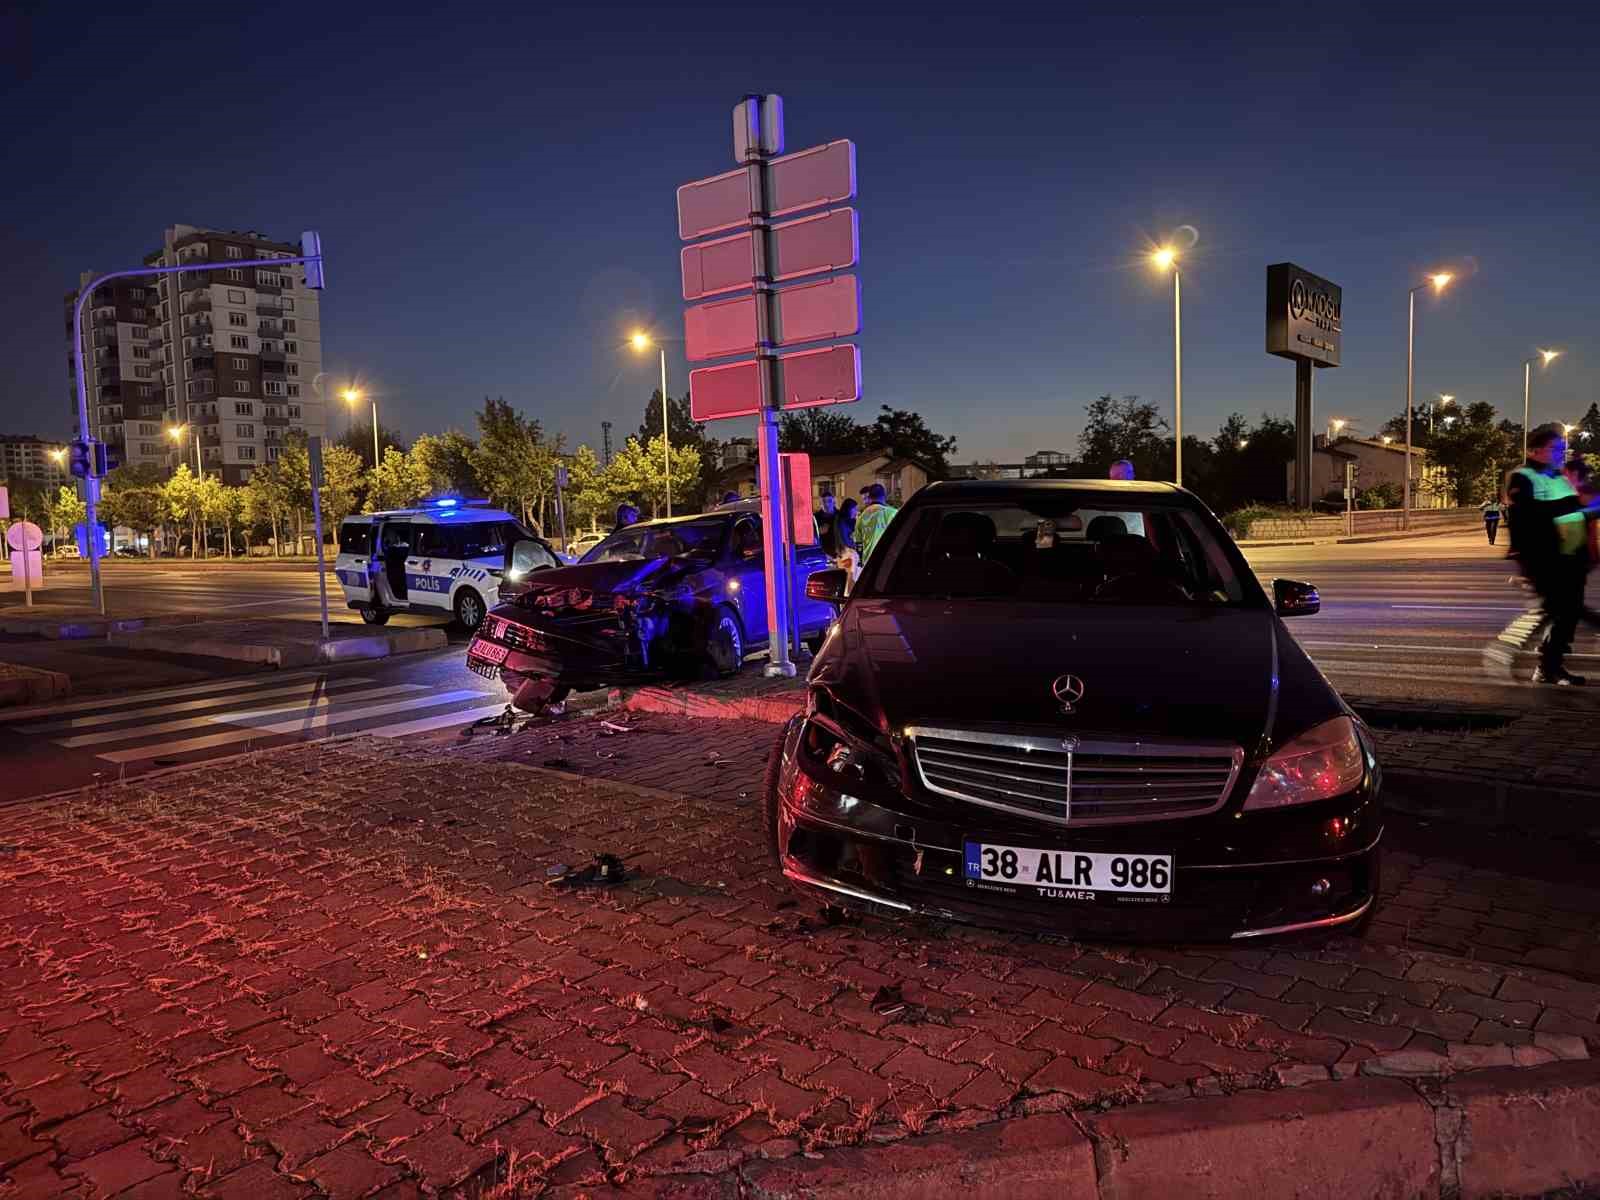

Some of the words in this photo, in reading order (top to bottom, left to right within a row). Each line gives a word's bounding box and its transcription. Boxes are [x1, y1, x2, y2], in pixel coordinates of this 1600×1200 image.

[415, 575, 441, 591] POLİS
[967, 862, 980, 872] TR
[982, 847, 1019, 880] 38
[1035, 852, 1093, 886] ALR
[1110, 857, 1170, 889] 986
